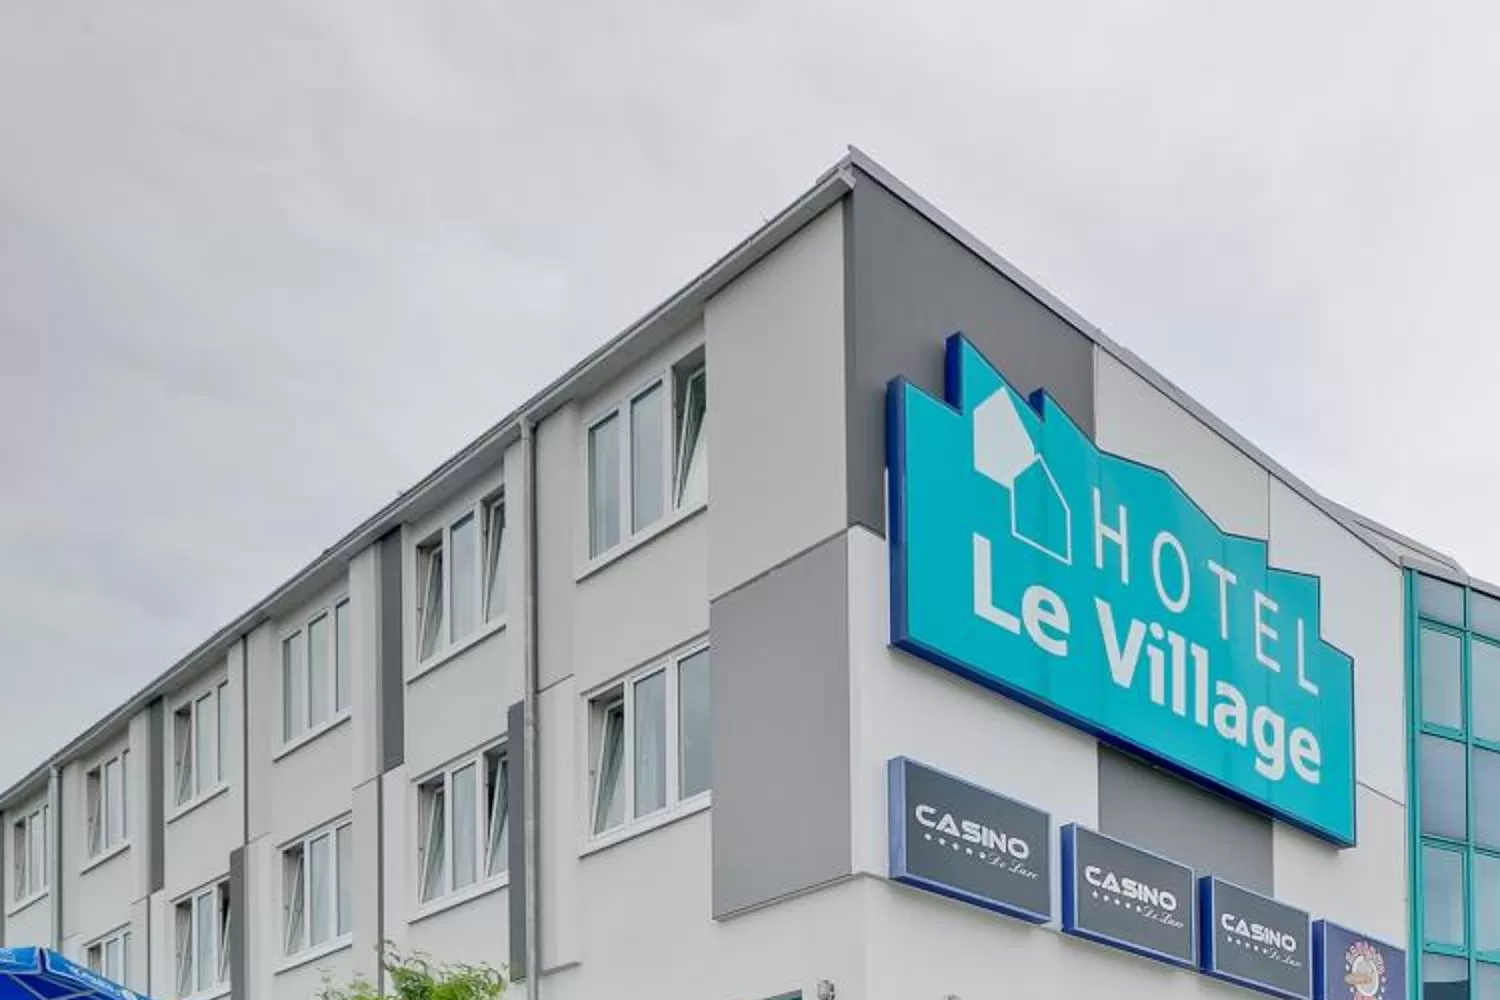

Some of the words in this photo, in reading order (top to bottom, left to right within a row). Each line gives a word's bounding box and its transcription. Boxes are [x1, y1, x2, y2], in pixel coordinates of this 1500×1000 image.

[1091, 486, 1320, 696] HOTEL
[972, 532, 1070, 657] Le
[1094, 595, 1321, 786] Village
[915, 804, 1030, 860] CASINO
[1084, 865, 1178, 912] CASINO
[1221, 912, 1298, 953] CASINO
